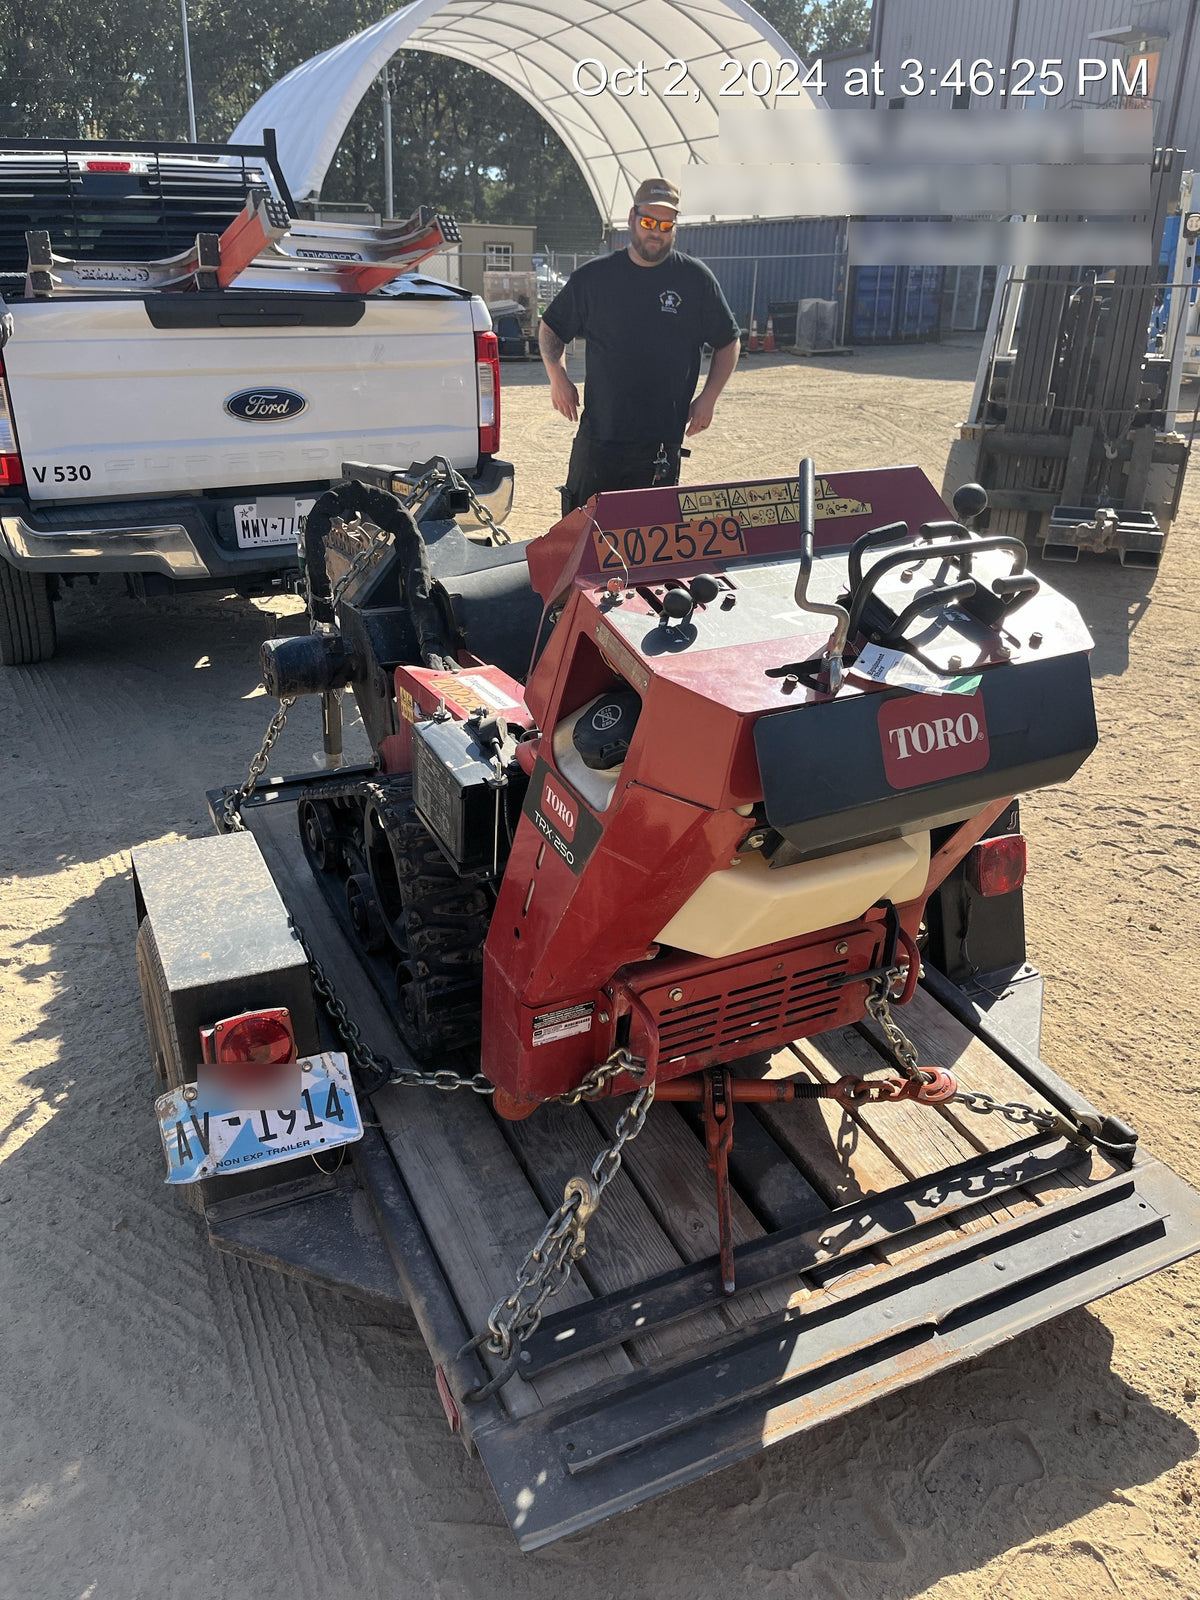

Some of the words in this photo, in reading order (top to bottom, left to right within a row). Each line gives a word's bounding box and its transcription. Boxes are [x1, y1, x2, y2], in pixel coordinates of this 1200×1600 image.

[245, 394, 290, 416] Ford
[32, 466, 47, 483] V
[54, 465, 92, 483] 530
[241, 518, 268, 539] MWY
[597, 517, 745, 569] 202529
[546, 785, 574, 828] TORO
[216, 1157, 240, 1169] NON
[243, 1151, 264, 1162] EXP
[266, 1139, 311, 1157] TRAILER
